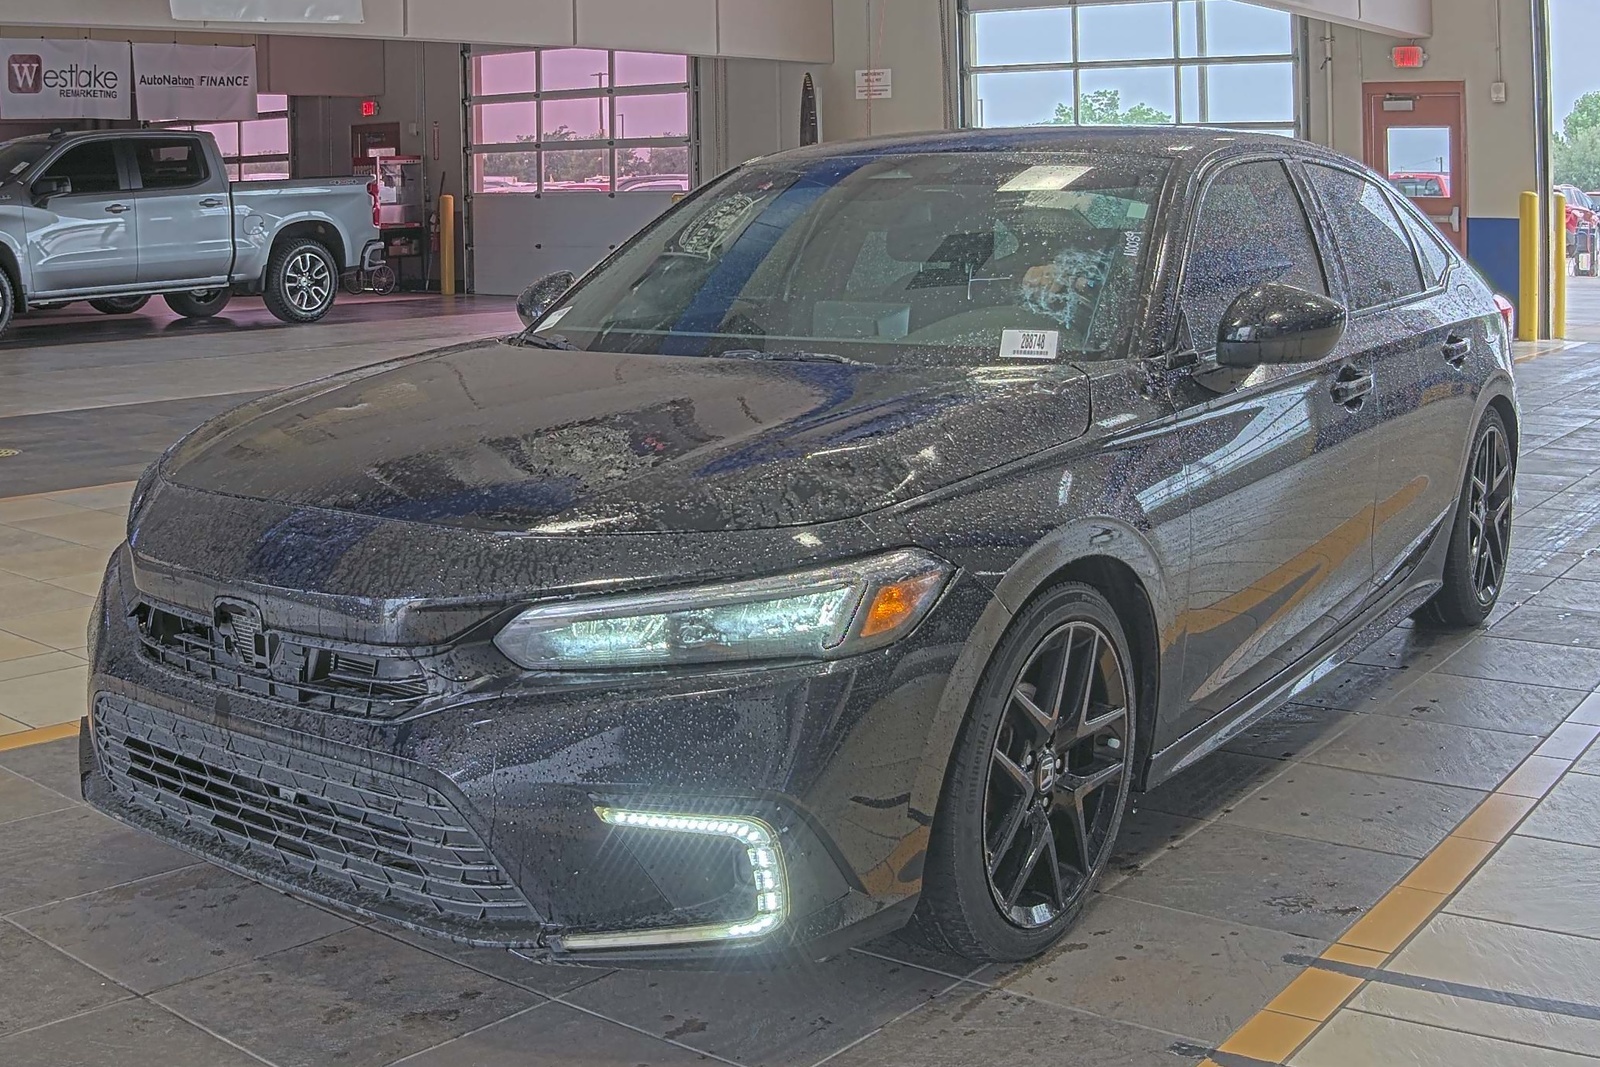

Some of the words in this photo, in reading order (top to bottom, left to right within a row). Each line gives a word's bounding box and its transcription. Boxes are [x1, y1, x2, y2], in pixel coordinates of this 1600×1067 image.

[11, 63, 118, 90] Westlake
[139, 75, 194, 86] AutoNation
[200, 75, 249, 86] FINANCE
[59, 89, 118, 99] REMARKETING
[1020, 333, 1046, 350] 288748
